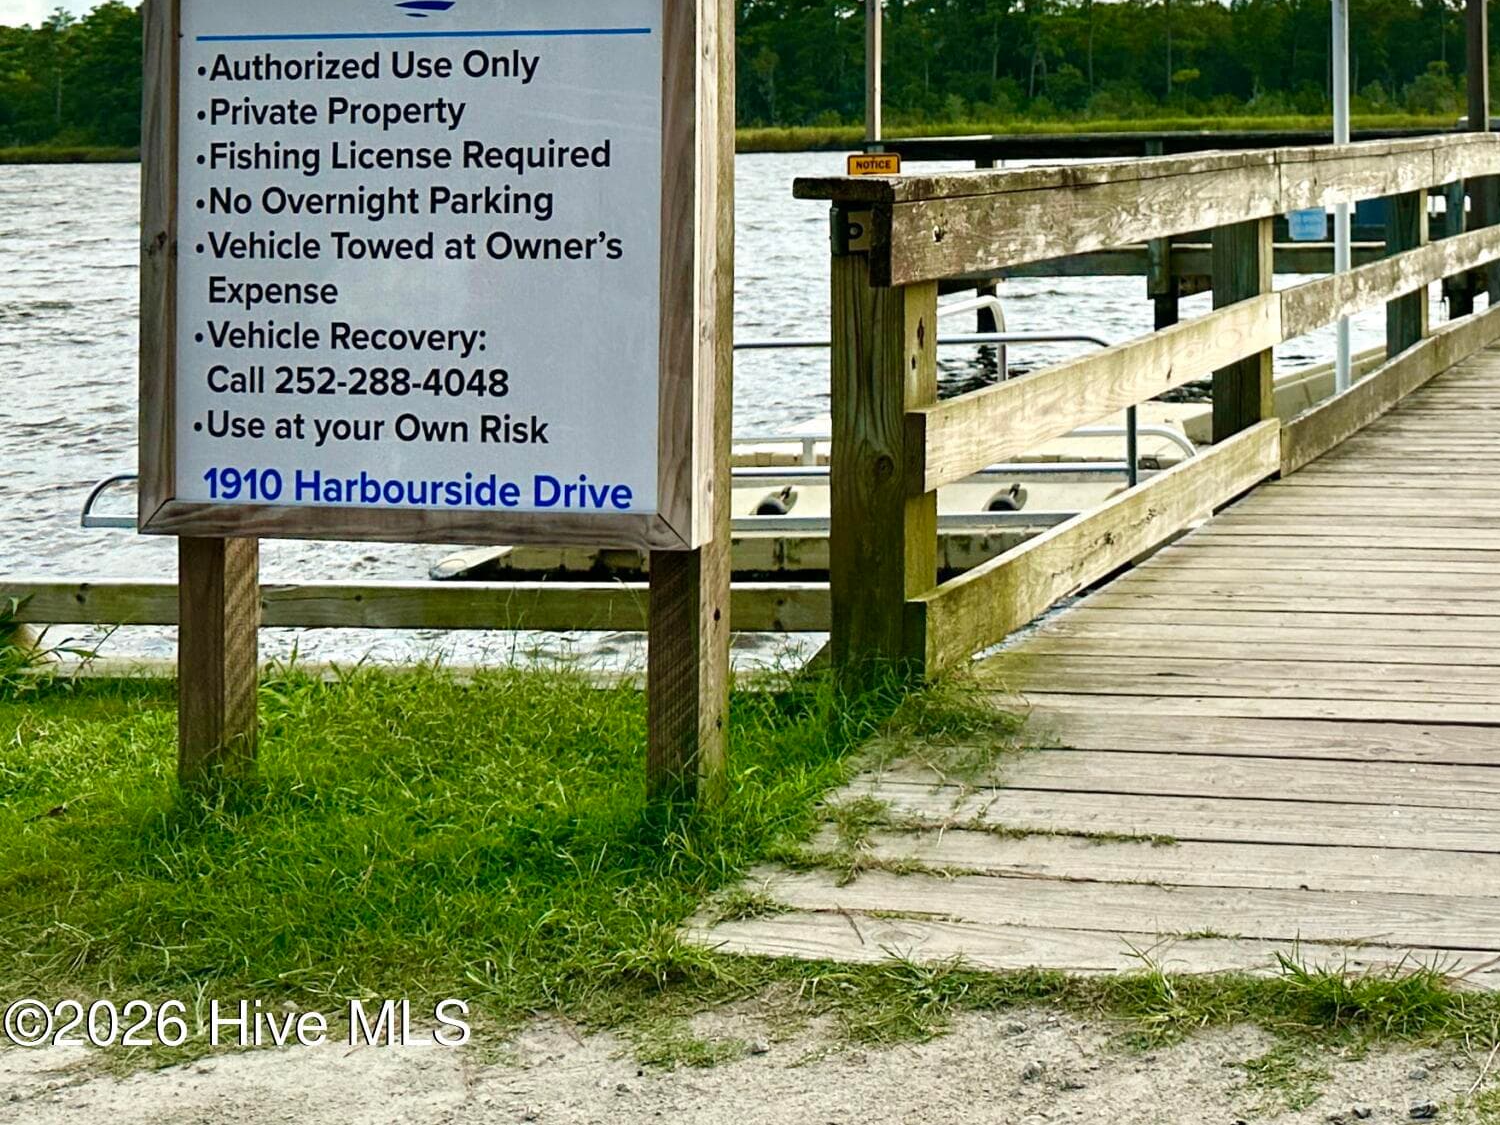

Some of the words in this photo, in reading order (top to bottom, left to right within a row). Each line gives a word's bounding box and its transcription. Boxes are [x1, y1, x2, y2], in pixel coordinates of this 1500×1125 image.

[209, 50, 380, 82] Authorized
[392, 50, 453, 79] Use
[463, 49, 540, 85] Only
[210, 96, 318, 126] Private
[328, 96, 466, 132] Property
[210, 140, 320, 177] Fishing
[331, 140, 452, 170] License
[463, 138, 611, 176] Required
[856, 159, 891, 169] NOTICE
[209, 186, 252, 215] No
[261, 185, 420, 222] Overnight
[430, 184, 553, 222] Parking
[207, 230, 321, 260] Vehicle
[330, 231, 434, 260] Towed
[444, 233, 476, 260] at
[486, 230, 623, 260] Owner’s
[208, 275, 339, 311] Expense
[206, 319, 320, 350] Vehicle
[330, 321, 487, 359] Recovery:
[207, 364, 265, 394] Call
[275, 366, 509, 398] 252-288-4048
[207, 409, 266, 439] Use
[275, 413, 305, 440] at
[313, 419, 385, 448] your
[394, 412, 469, 443] Own
[480, 413, 549, 444] Risk
[203, 467, 283, 501] 1910
[295, 469, 521, 507] Harbourside
[533, 473, 633, 510] Drive
